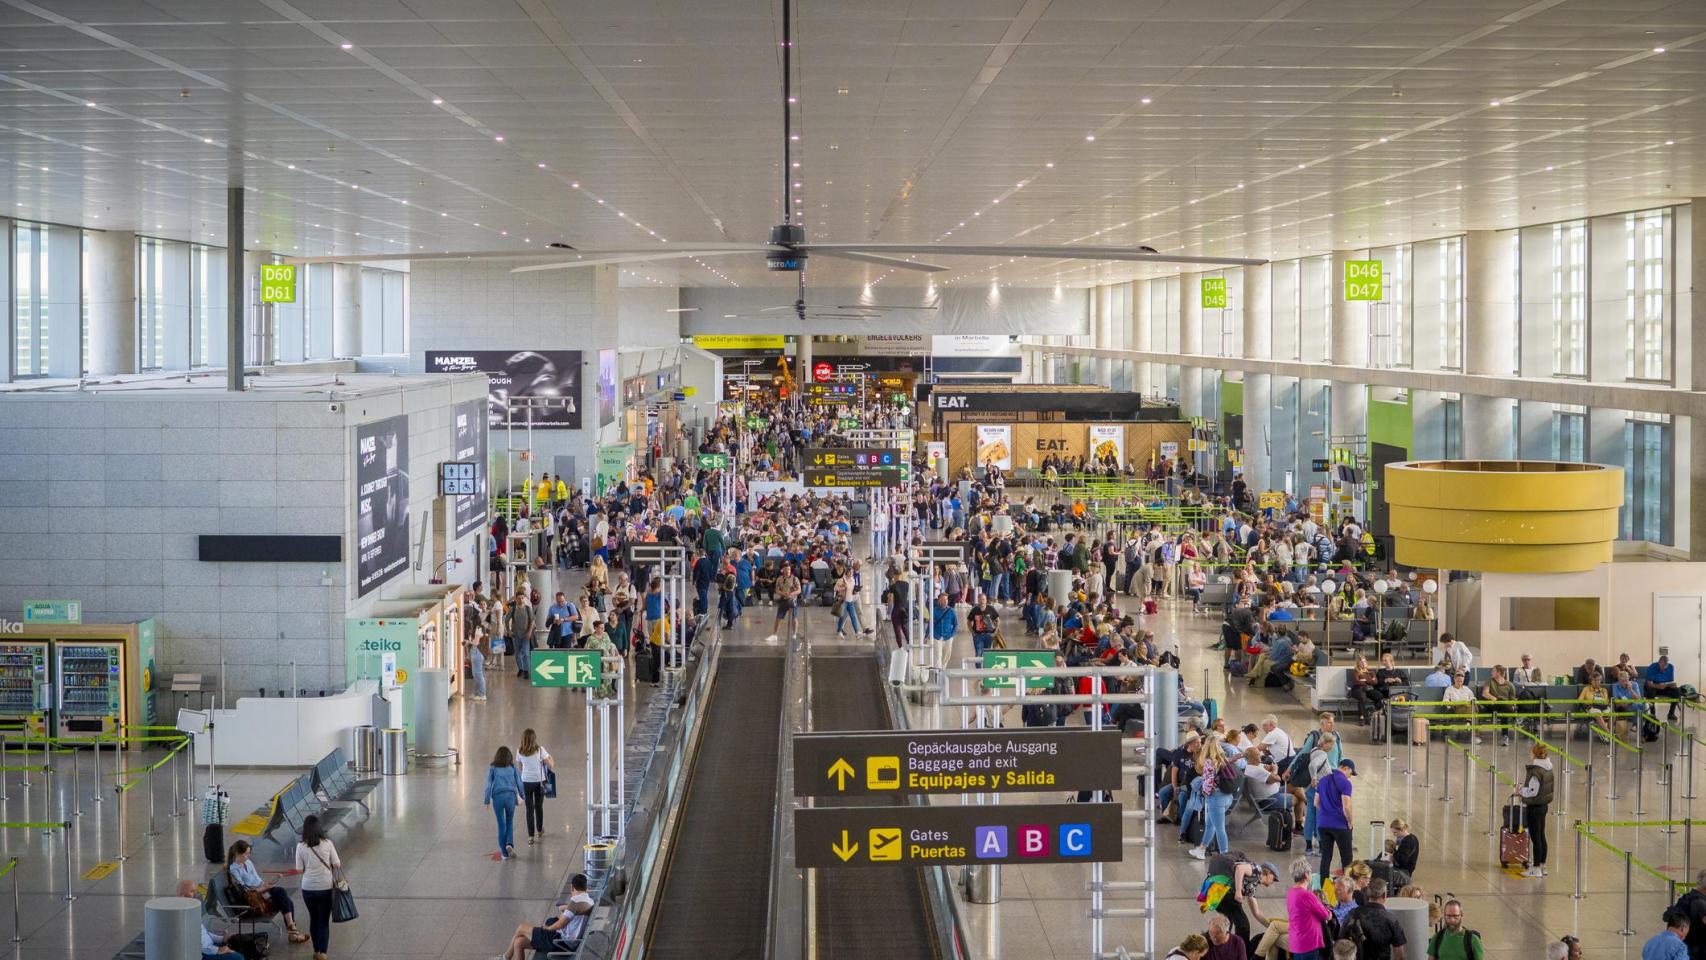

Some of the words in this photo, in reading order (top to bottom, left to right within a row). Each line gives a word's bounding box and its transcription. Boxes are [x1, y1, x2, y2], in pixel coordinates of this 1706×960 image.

[265, 268, 292, 281] D60
[1349, 264, 1379, 278] D46
[265, 286, 291, 299] D61
[1204, 281, 1224, 292] D44
[1350, 283, 1379, 297] D47
[1204, 295, 1224, 306] D45
[435, 356, 477, 365] MAMZEL
[937, 396, 969, 408] EAT.
[1036, 438, 1069, 451] EAT.
[363, 638, 401, 651] teika
[908, 741, 1002, 756] Gepäckausgabe
[1006, 740, 1057, 755] Ausgang
[908, 757, 963, 771] Baggage
[968, 757, 990, 768] and
[995, 756, 1018, 768] exit
[908, 773, 986, 789] Equipajes
[992, 774, 1000, 788] y
[1006, 771, 1055, 785] Salida
[910, 829, 949, 841] Gates
[982, 831, 1000, 853] A
[1026, 830, 1043, 852] B
[1066, 829, 1084, 851] C
[910, 845, 966, 858] Puertas
